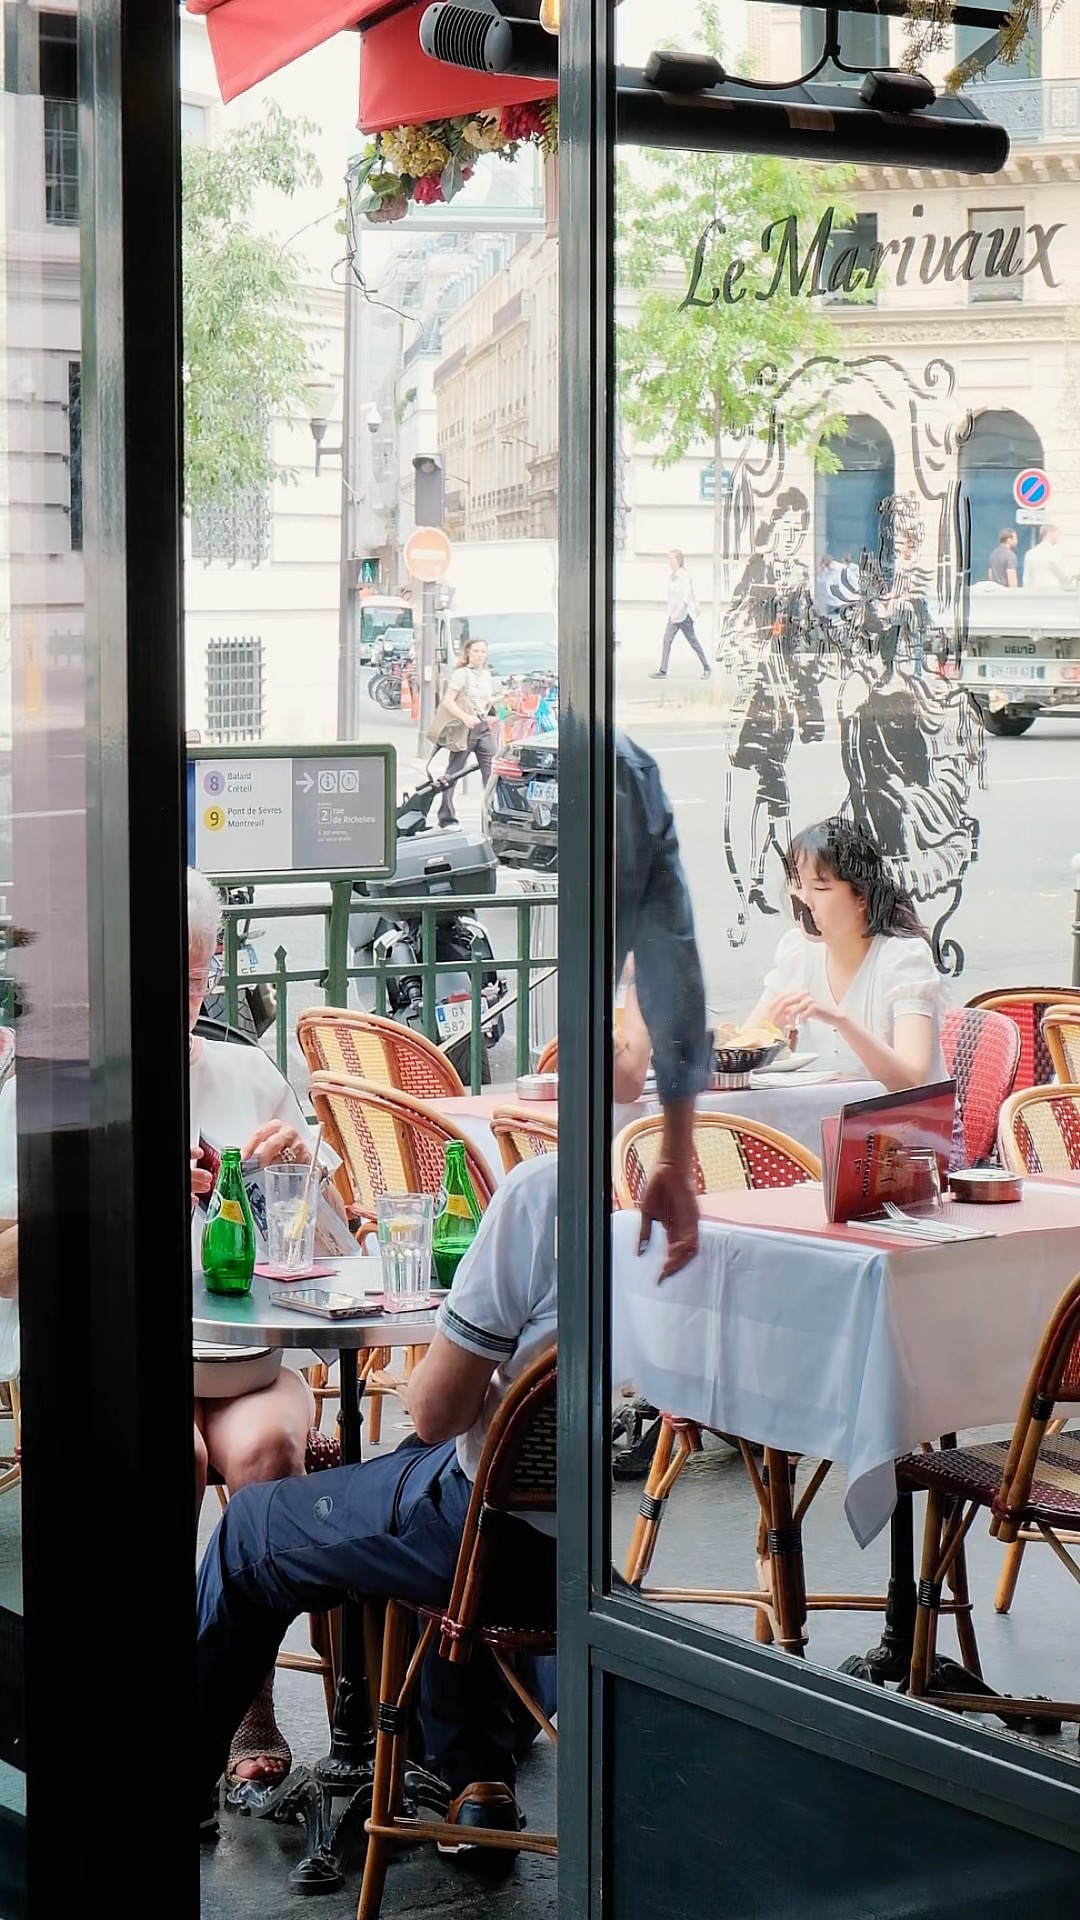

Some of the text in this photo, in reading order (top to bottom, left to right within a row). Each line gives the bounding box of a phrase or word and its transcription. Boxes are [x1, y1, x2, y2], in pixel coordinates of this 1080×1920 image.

[677, 204, 1068, 313] Le Marivaux
[227, 771, 252, 780] Balard
[210, 775, 219, 791] 8
[227, 807, 245, 816] Pont
[246, 806, 257, 815] de
[320, 809, 329, 821] 2
[209, 811, 219, 827] 9
[227, 818, 264, 828] Montreuil
[332, 814, 376, 824] de Richelieu
[451, 1006, 466, 1018] GX
